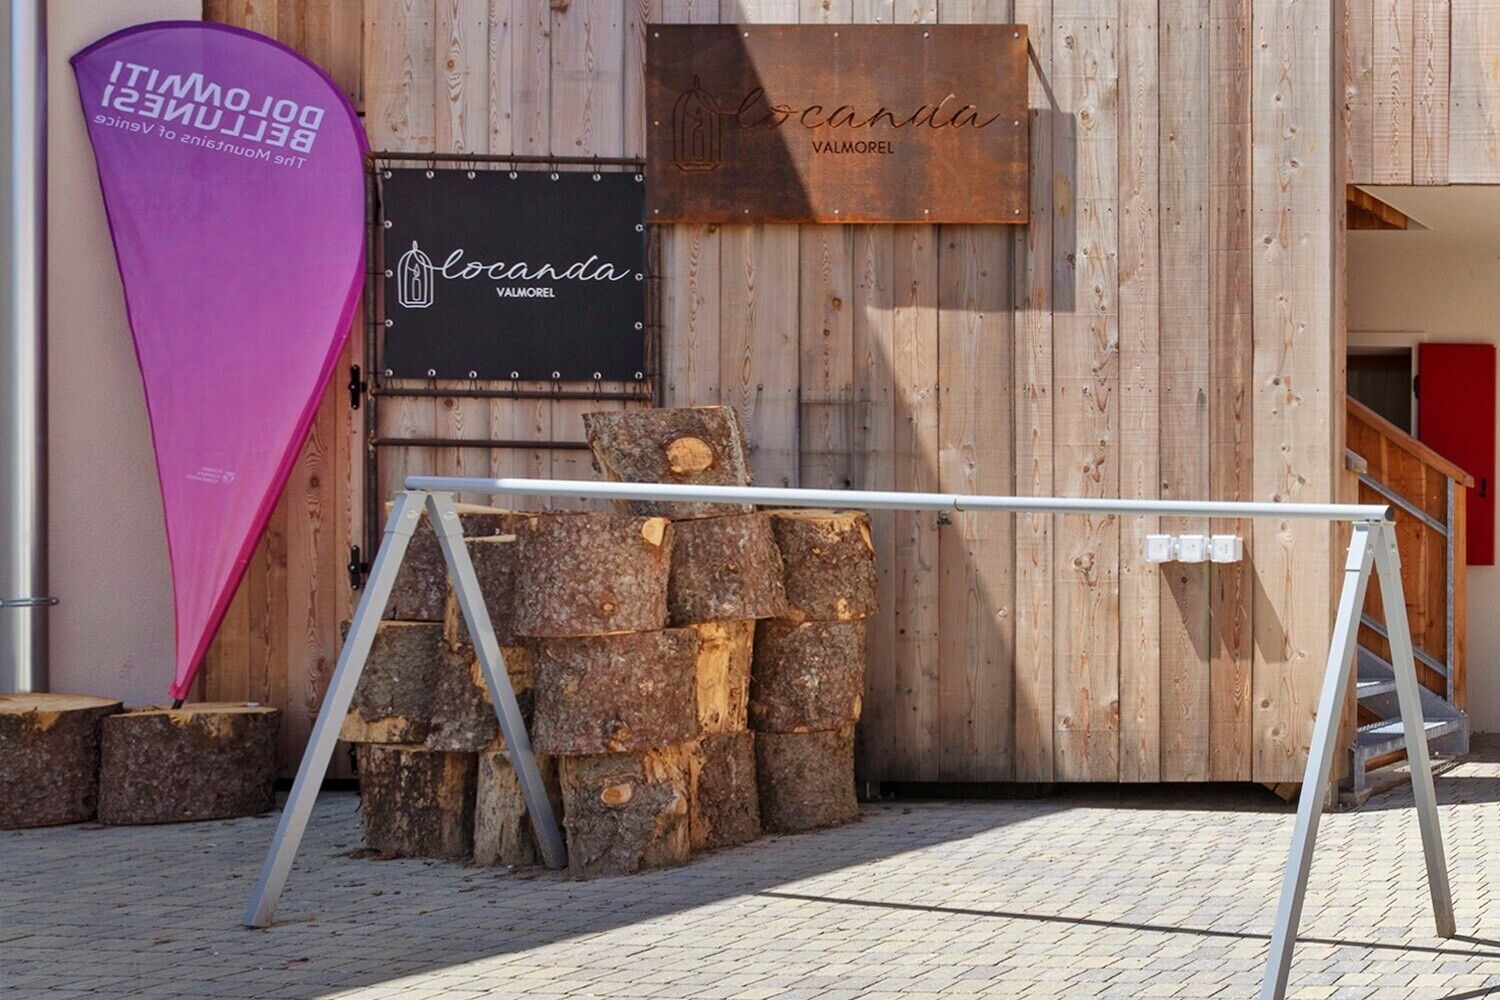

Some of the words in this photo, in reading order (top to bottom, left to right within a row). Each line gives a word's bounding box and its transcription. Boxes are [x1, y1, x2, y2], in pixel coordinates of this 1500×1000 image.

[733, 86, 1000, 130] locanda
[812, 141, 895, 155] VALMOREL
[441, 248, 631, 281] locanda
[496, 287, 556, 298] VALMOREL
